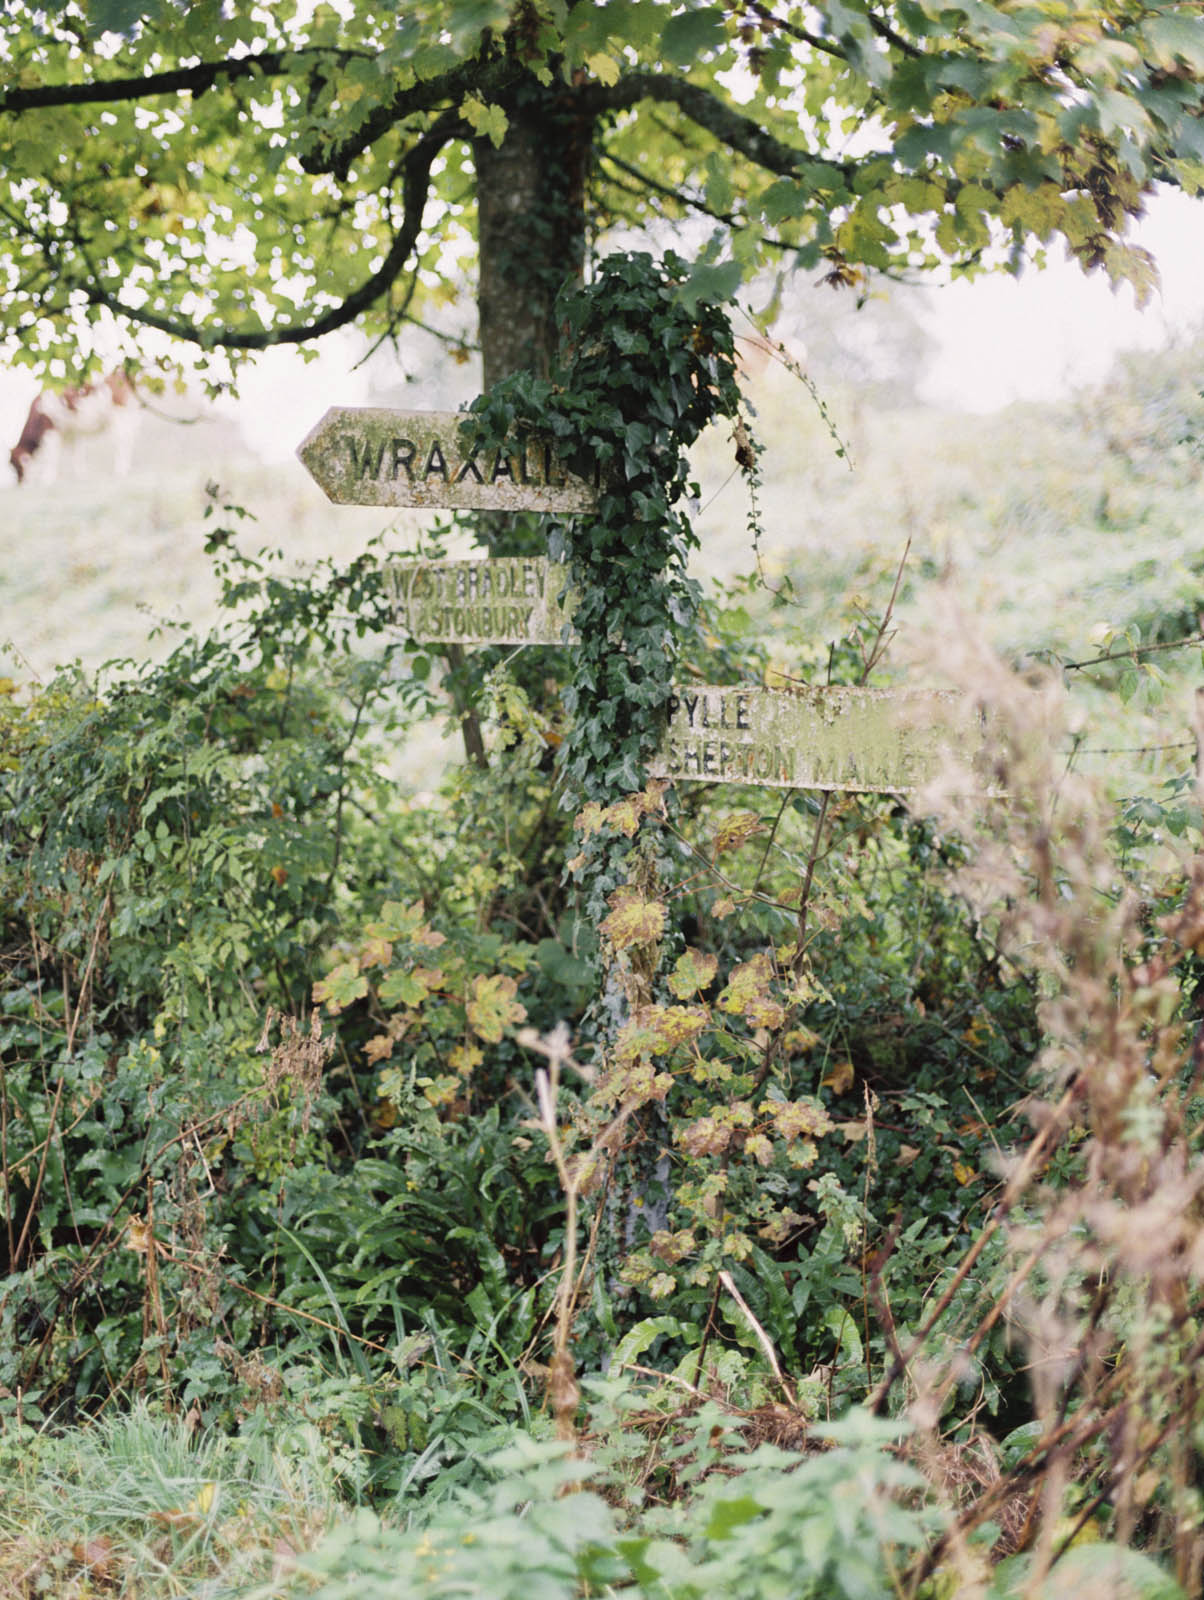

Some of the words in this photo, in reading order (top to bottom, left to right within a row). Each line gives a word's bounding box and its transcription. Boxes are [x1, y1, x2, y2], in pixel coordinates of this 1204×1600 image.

[345, 437, 565, 487] WRAXALL
[456, 563, 546, 600] BRADLEY
[667, 694, 751, 729] PYLLE
